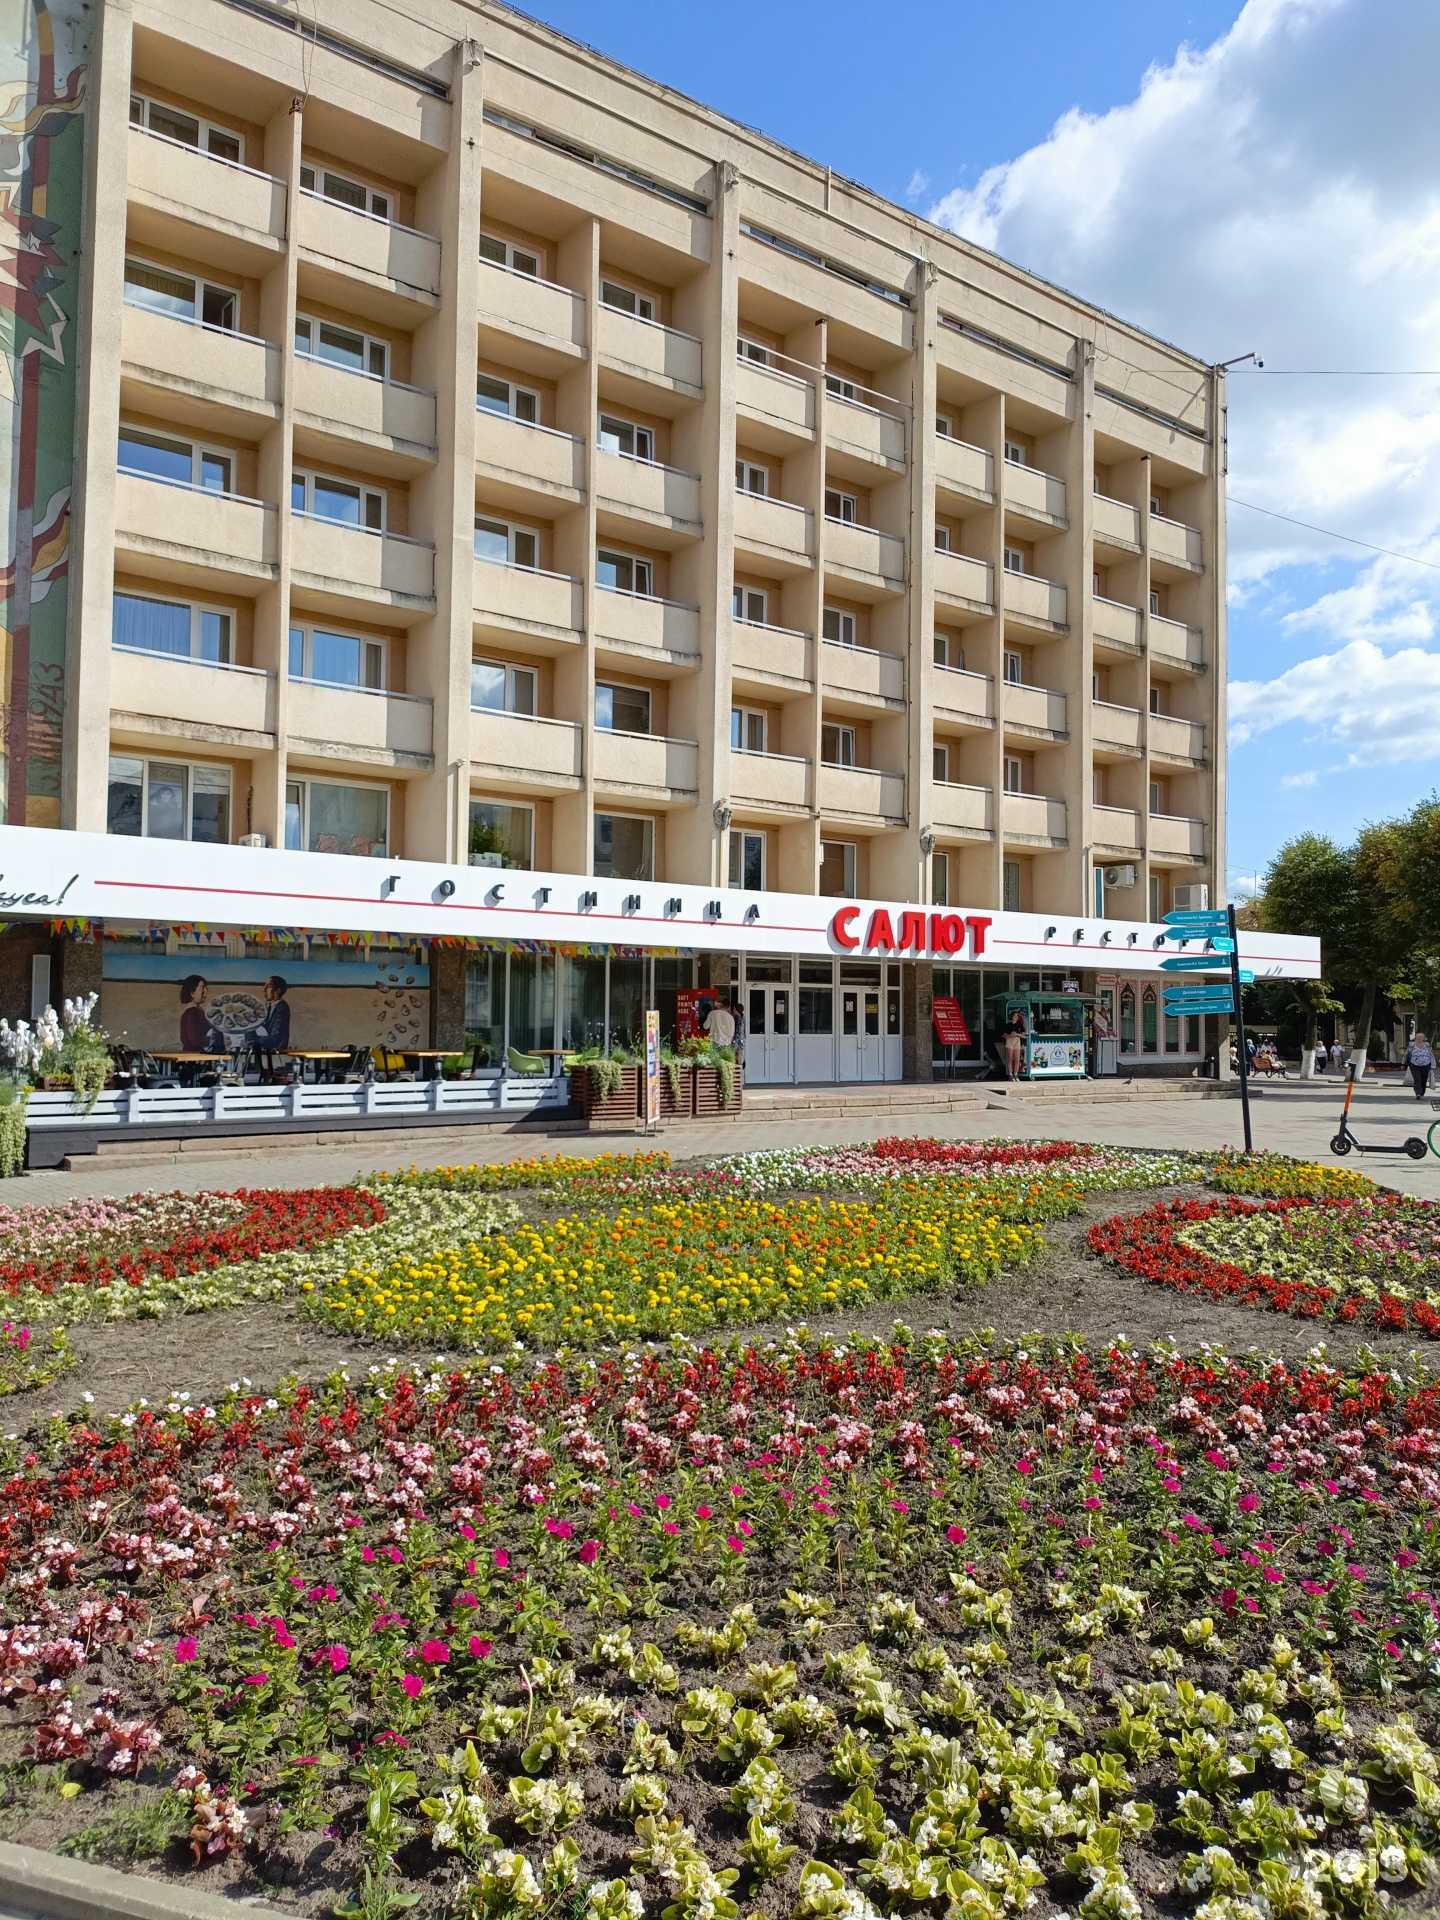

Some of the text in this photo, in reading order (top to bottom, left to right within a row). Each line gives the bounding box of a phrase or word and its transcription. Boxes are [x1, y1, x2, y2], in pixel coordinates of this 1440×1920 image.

[387, 875, 761, 919] ГОСТИНИЦА
[832, 906, 993, 954] САЛЮТ
[1047, 926, 1215, 949] РЕСТОРА
